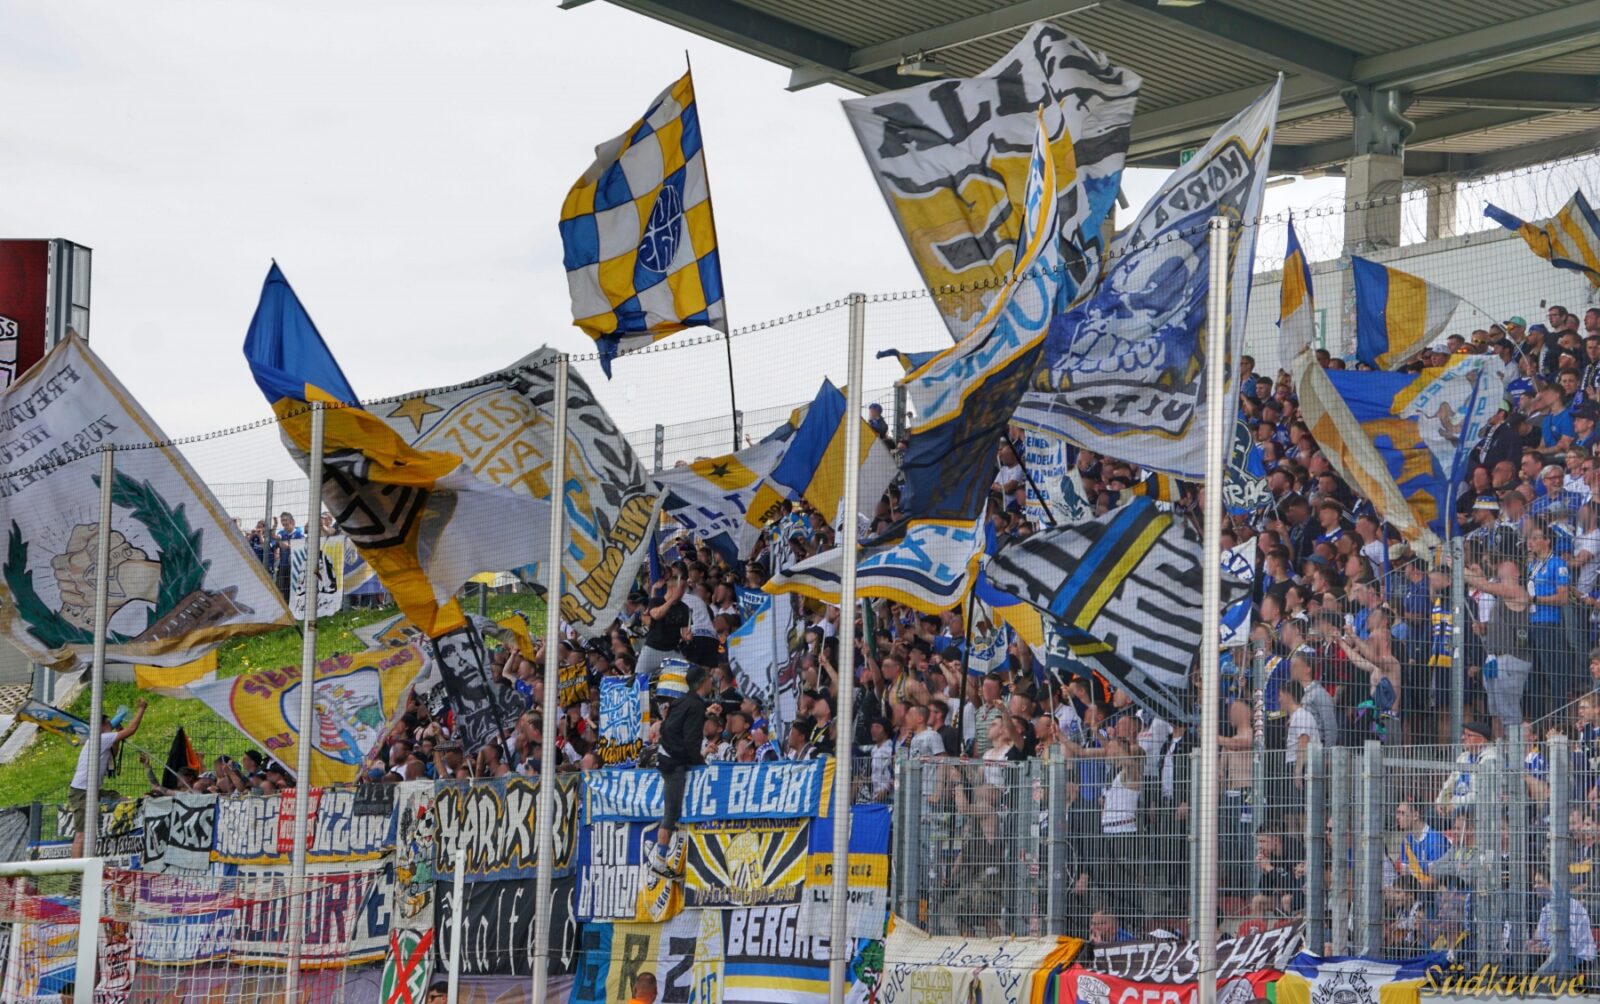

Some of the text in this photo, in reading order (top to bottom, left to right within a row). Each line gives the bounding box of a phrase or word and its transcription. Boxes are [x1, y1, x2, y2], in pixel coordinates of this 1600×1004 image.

[1223, 479, 1272, 506] TRAS
[590, 764, 818, 819] SÜDKUVE BLEIBT
